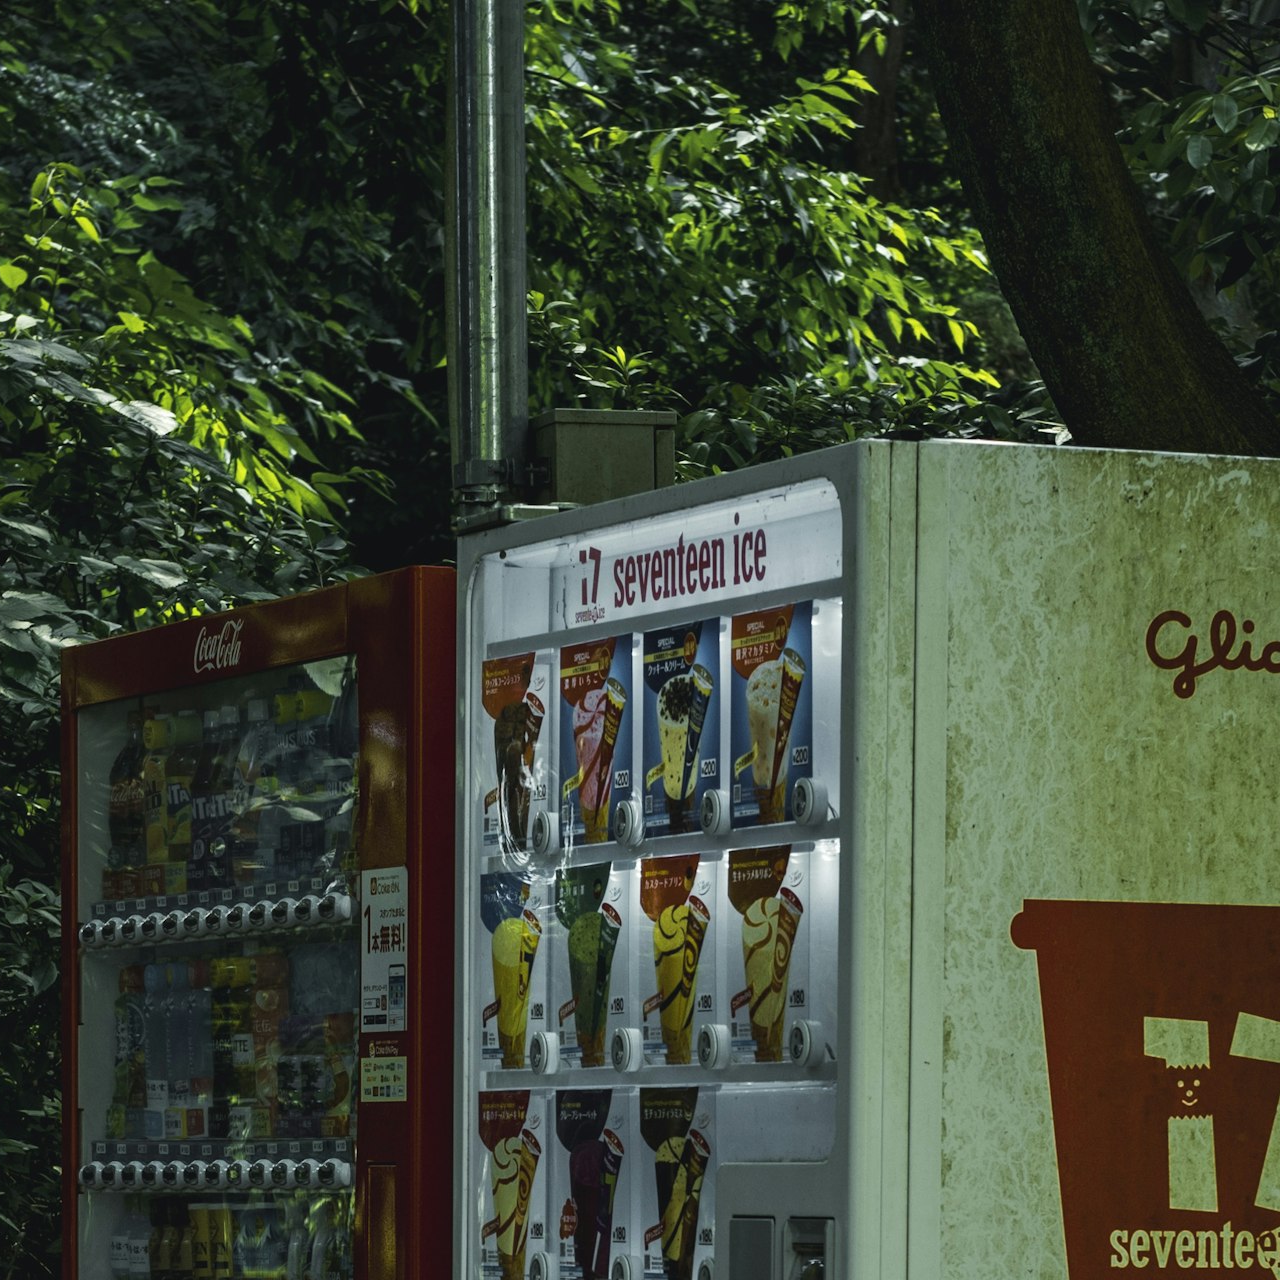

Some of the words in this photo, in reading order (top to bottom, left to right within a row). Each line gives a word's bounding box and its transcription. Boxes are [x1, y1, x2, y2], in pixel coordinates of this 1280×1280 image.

[614, 533, 726, 608] seventeen
[734, 512, 767, 584] ice
[194, 618, 245, 674] Coca-Cola
[364, 904, 406, 955] 1本無料!
